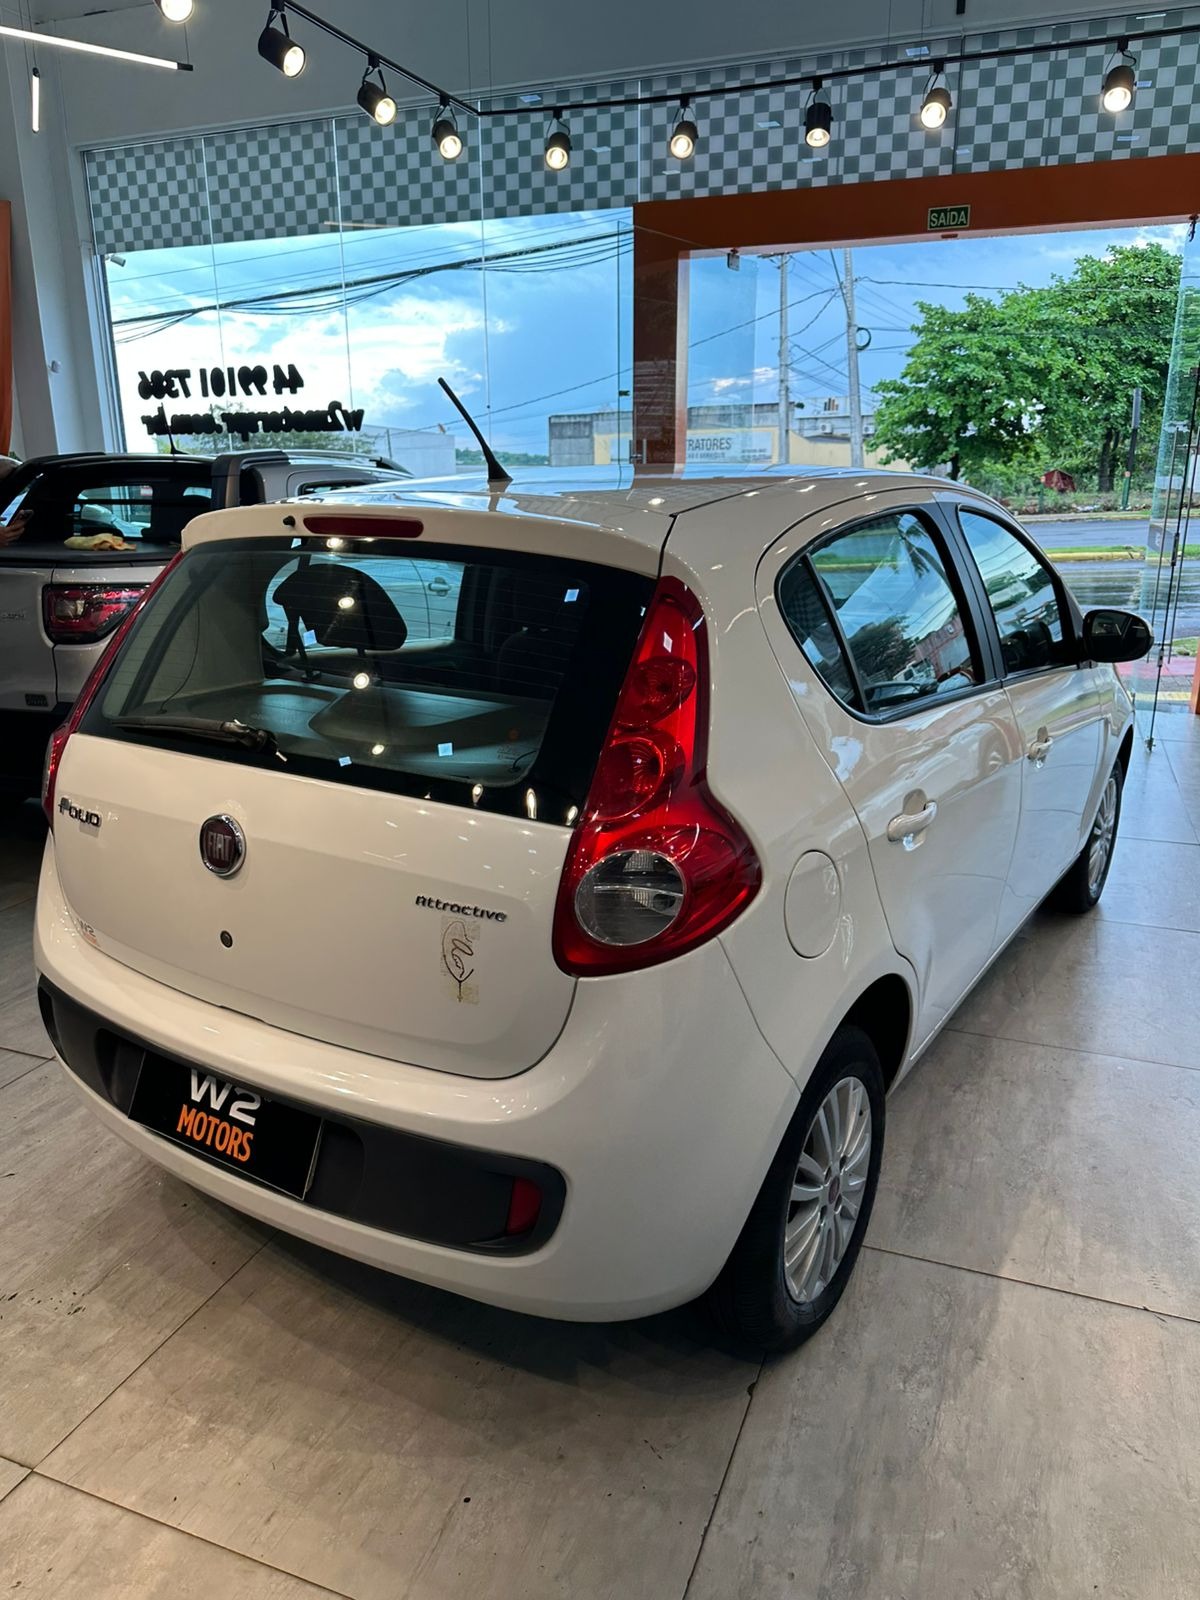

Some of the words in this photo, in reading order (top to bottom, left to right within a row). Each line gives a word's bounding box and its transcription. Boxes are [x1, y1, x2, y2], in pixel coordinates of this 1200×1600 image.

[930, 207, 967, 227] SAÍDA
[415, 895, 507, 922] Attractive
[190, 1068, 262, 1126] W2
[176, 1103, 254, 1162] MOTORS
